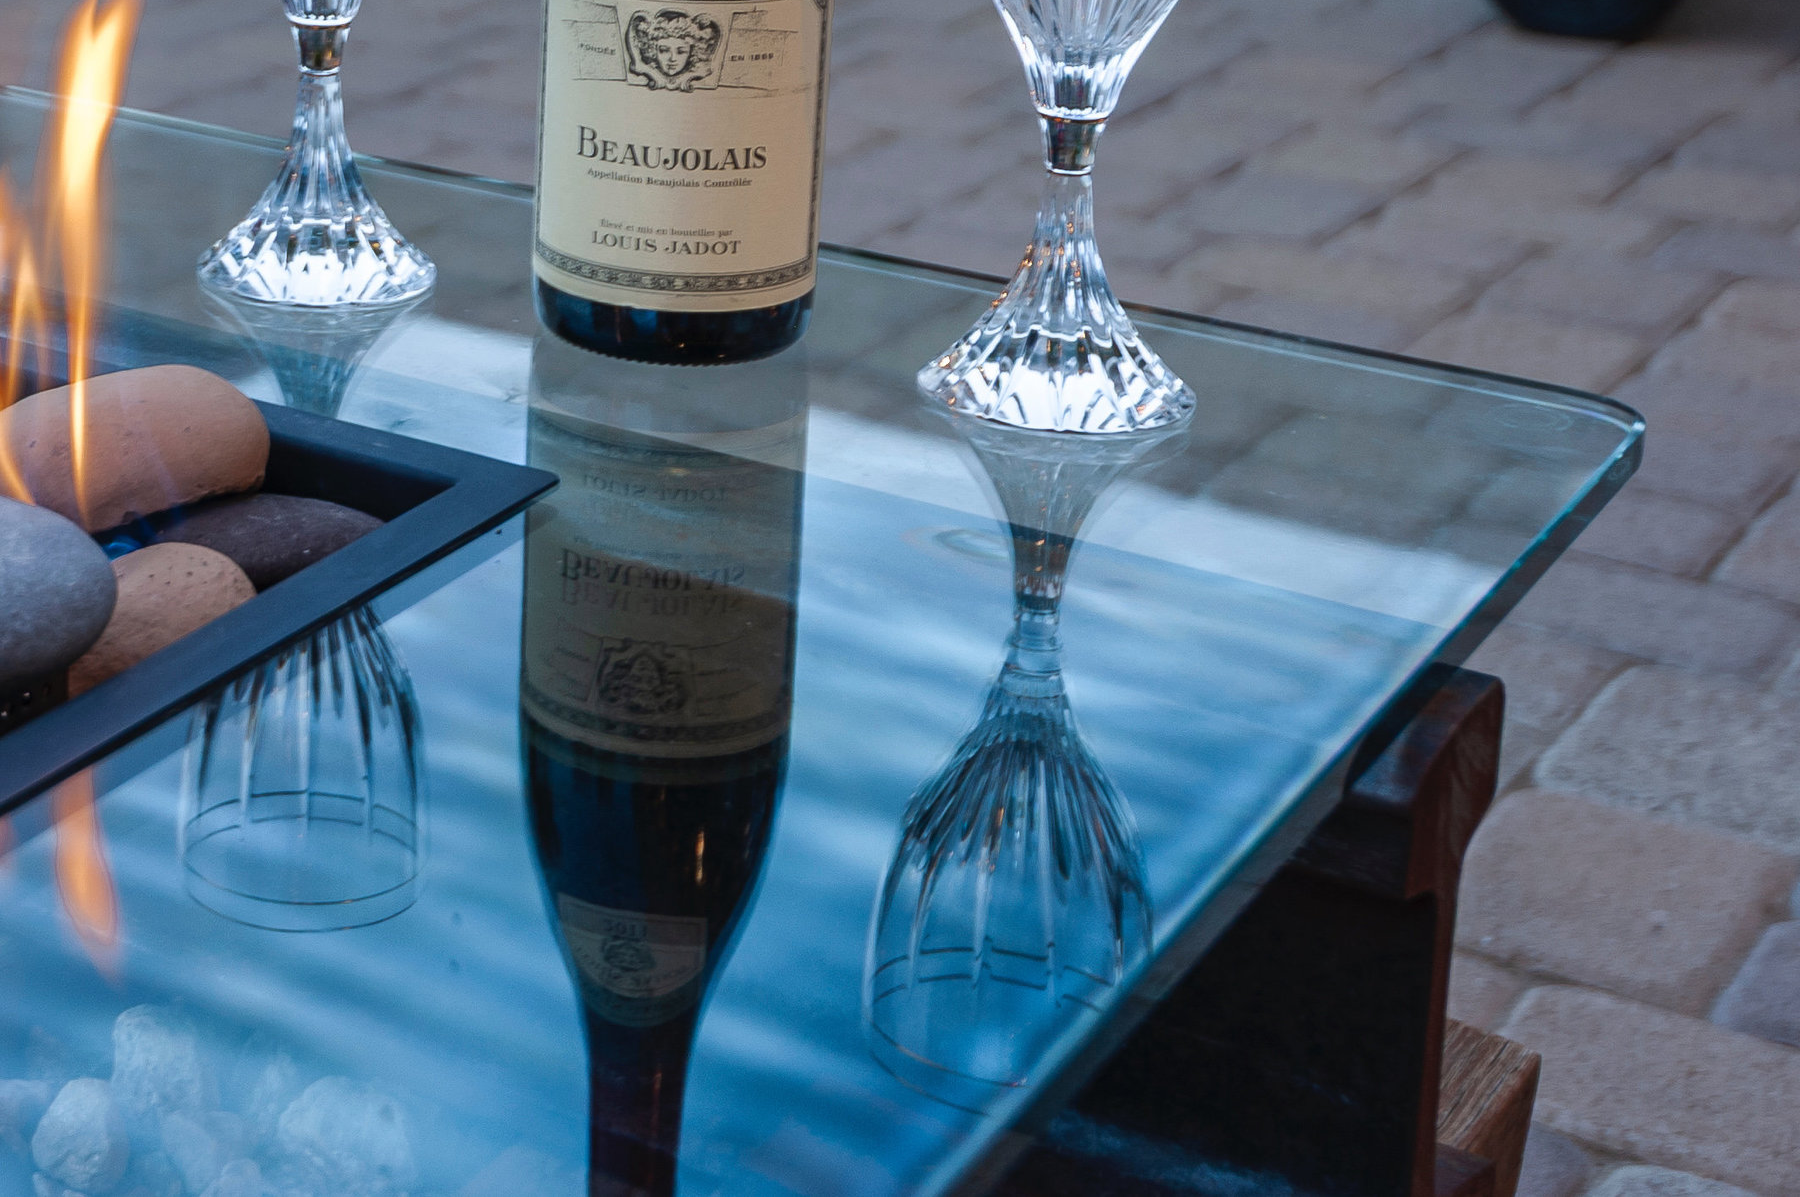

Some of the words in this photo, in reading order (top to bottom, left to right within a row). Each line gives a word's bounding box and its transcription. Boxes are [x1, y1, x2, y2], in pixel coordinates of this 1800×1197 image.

[576, 124, 768, 171] BEAUJOLAIS
[587, 167, 644, 184] Appellation
[646, 176, 701, 188] Beaujolais
[591, 230, 658, 253] LOUIS
[664, 239, 742, 255] JADOT
[625, 224, 634, 232] et
[636, 225, 653, 234] mis
[670, 228, 715, 237] bouteilles
[718, 229, 734, 238] par
